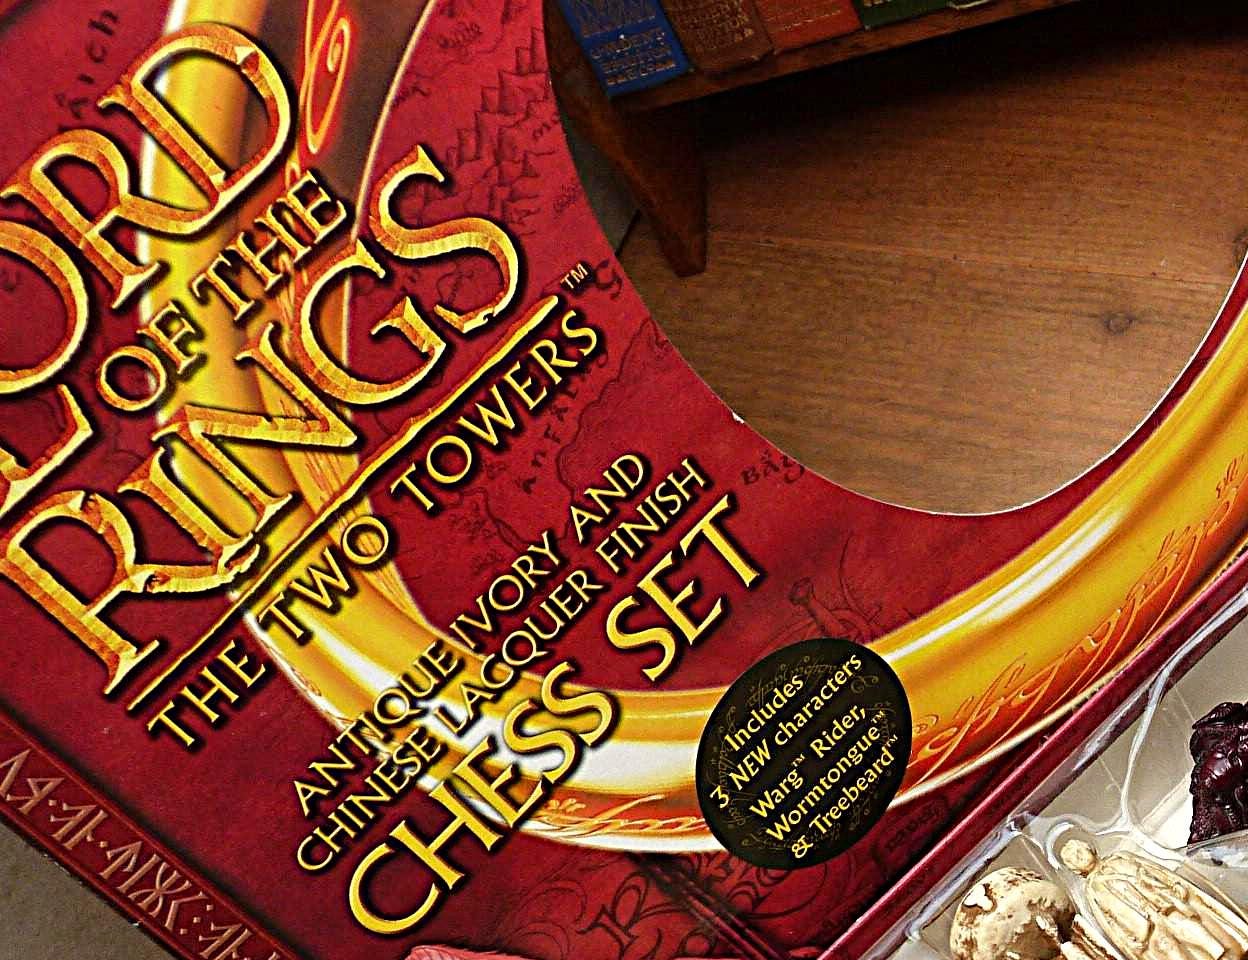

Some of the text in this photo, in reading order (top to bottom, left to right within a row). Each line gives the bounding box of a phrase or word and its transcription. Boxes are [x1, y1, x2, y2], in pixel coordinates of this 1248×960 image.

[0, 145, 519, 694] RINGS
[99, 171, 346, 410] OF THE
[148, 309, 598, 746] THE TWO TOWERS
[293, 454, 645, 816] ANTIQUE IVORY AND
[297, 728, 442, 870] CHINESE
[434, 569, 603, 733] LACQUER
[595, 458, 706, 573] FINISH
[349, 661, 614, 934] CHESS
[606, 494, 760, 682] SET
[709, 653, 862, 809] 3 NEW characters
[724, 673, 804, 752] Includes
[791, 835, 814, 859] &
[809, 704, 866, 758] Rider,
